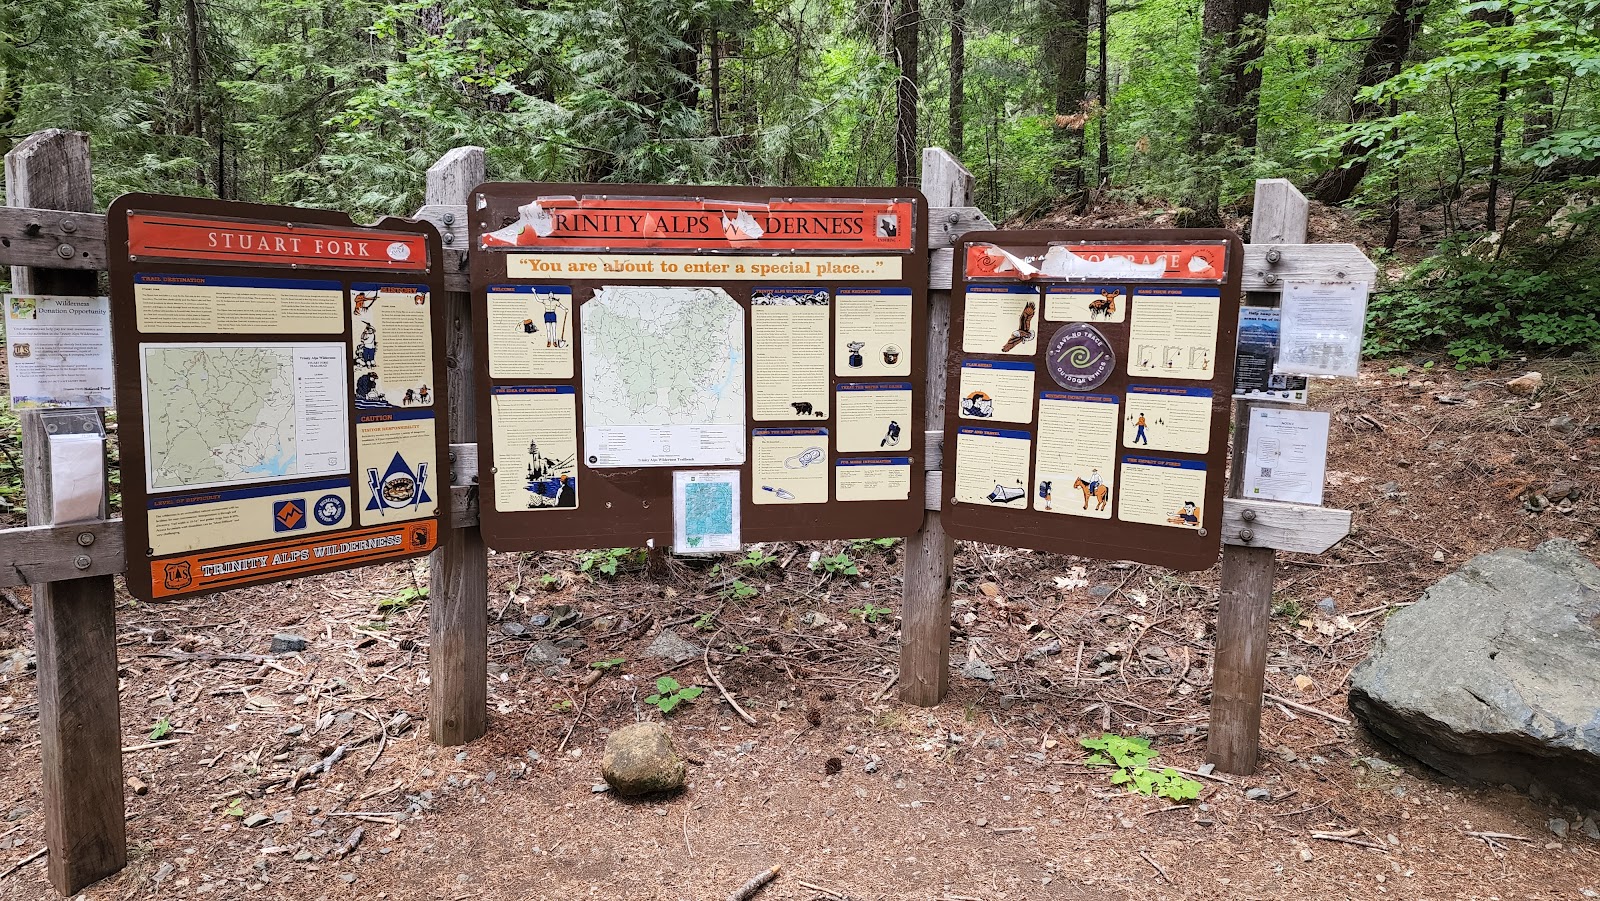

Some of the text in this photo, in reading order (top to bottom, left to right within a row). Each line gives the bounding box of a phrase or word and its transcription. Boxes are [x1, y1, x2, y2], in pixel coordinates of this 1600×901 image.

[555, 213, 643, 233] RINITY
[654, 215, 709, 233] ALPS
[719, 217, 864, 235] WDERNESS
[208, 232, 370, 256] STUART FORK
[568, 262, 598, 272] are
[603, 260, 654, 272] about
[660, 261, 678, 272] to
[684, 261, 730, 274] enter
[735, 263, 746, 274] a
[751, 261, 811, 276] special
[1056, 335, 1070, 352] LEAVE
[1084, 332, 1102, 346] TRACE
[1058, 362, 1106, 383] OUTDOOR ETHICS
[201, 534, 402, 577] TRINITY ALPS WILDERNESS
